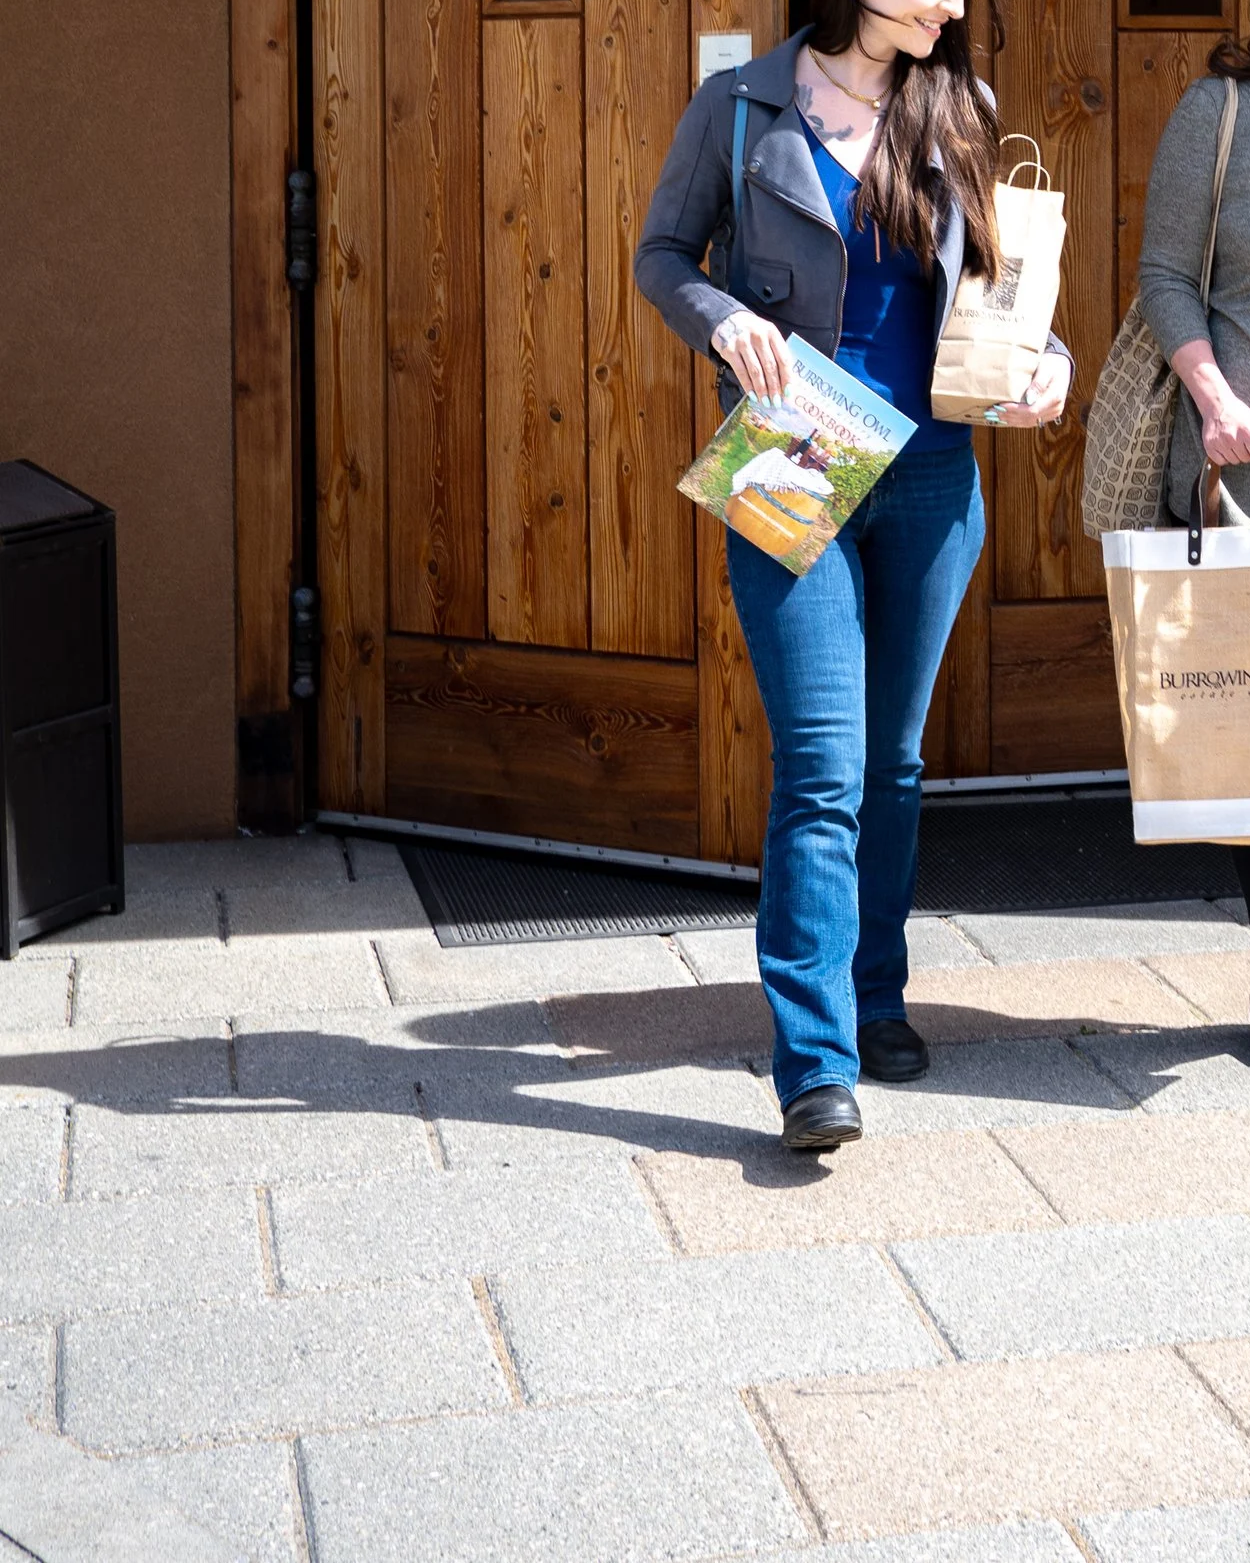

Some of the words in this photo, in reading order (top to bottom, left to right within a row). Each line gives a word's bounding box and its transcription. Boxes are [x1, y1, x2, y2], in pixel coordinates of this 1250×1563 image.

[792, 359, 863, 418] BURROWING
[862, 413, 892, 442] OWL
[794, 395, 861, 450] COOKBOOK
